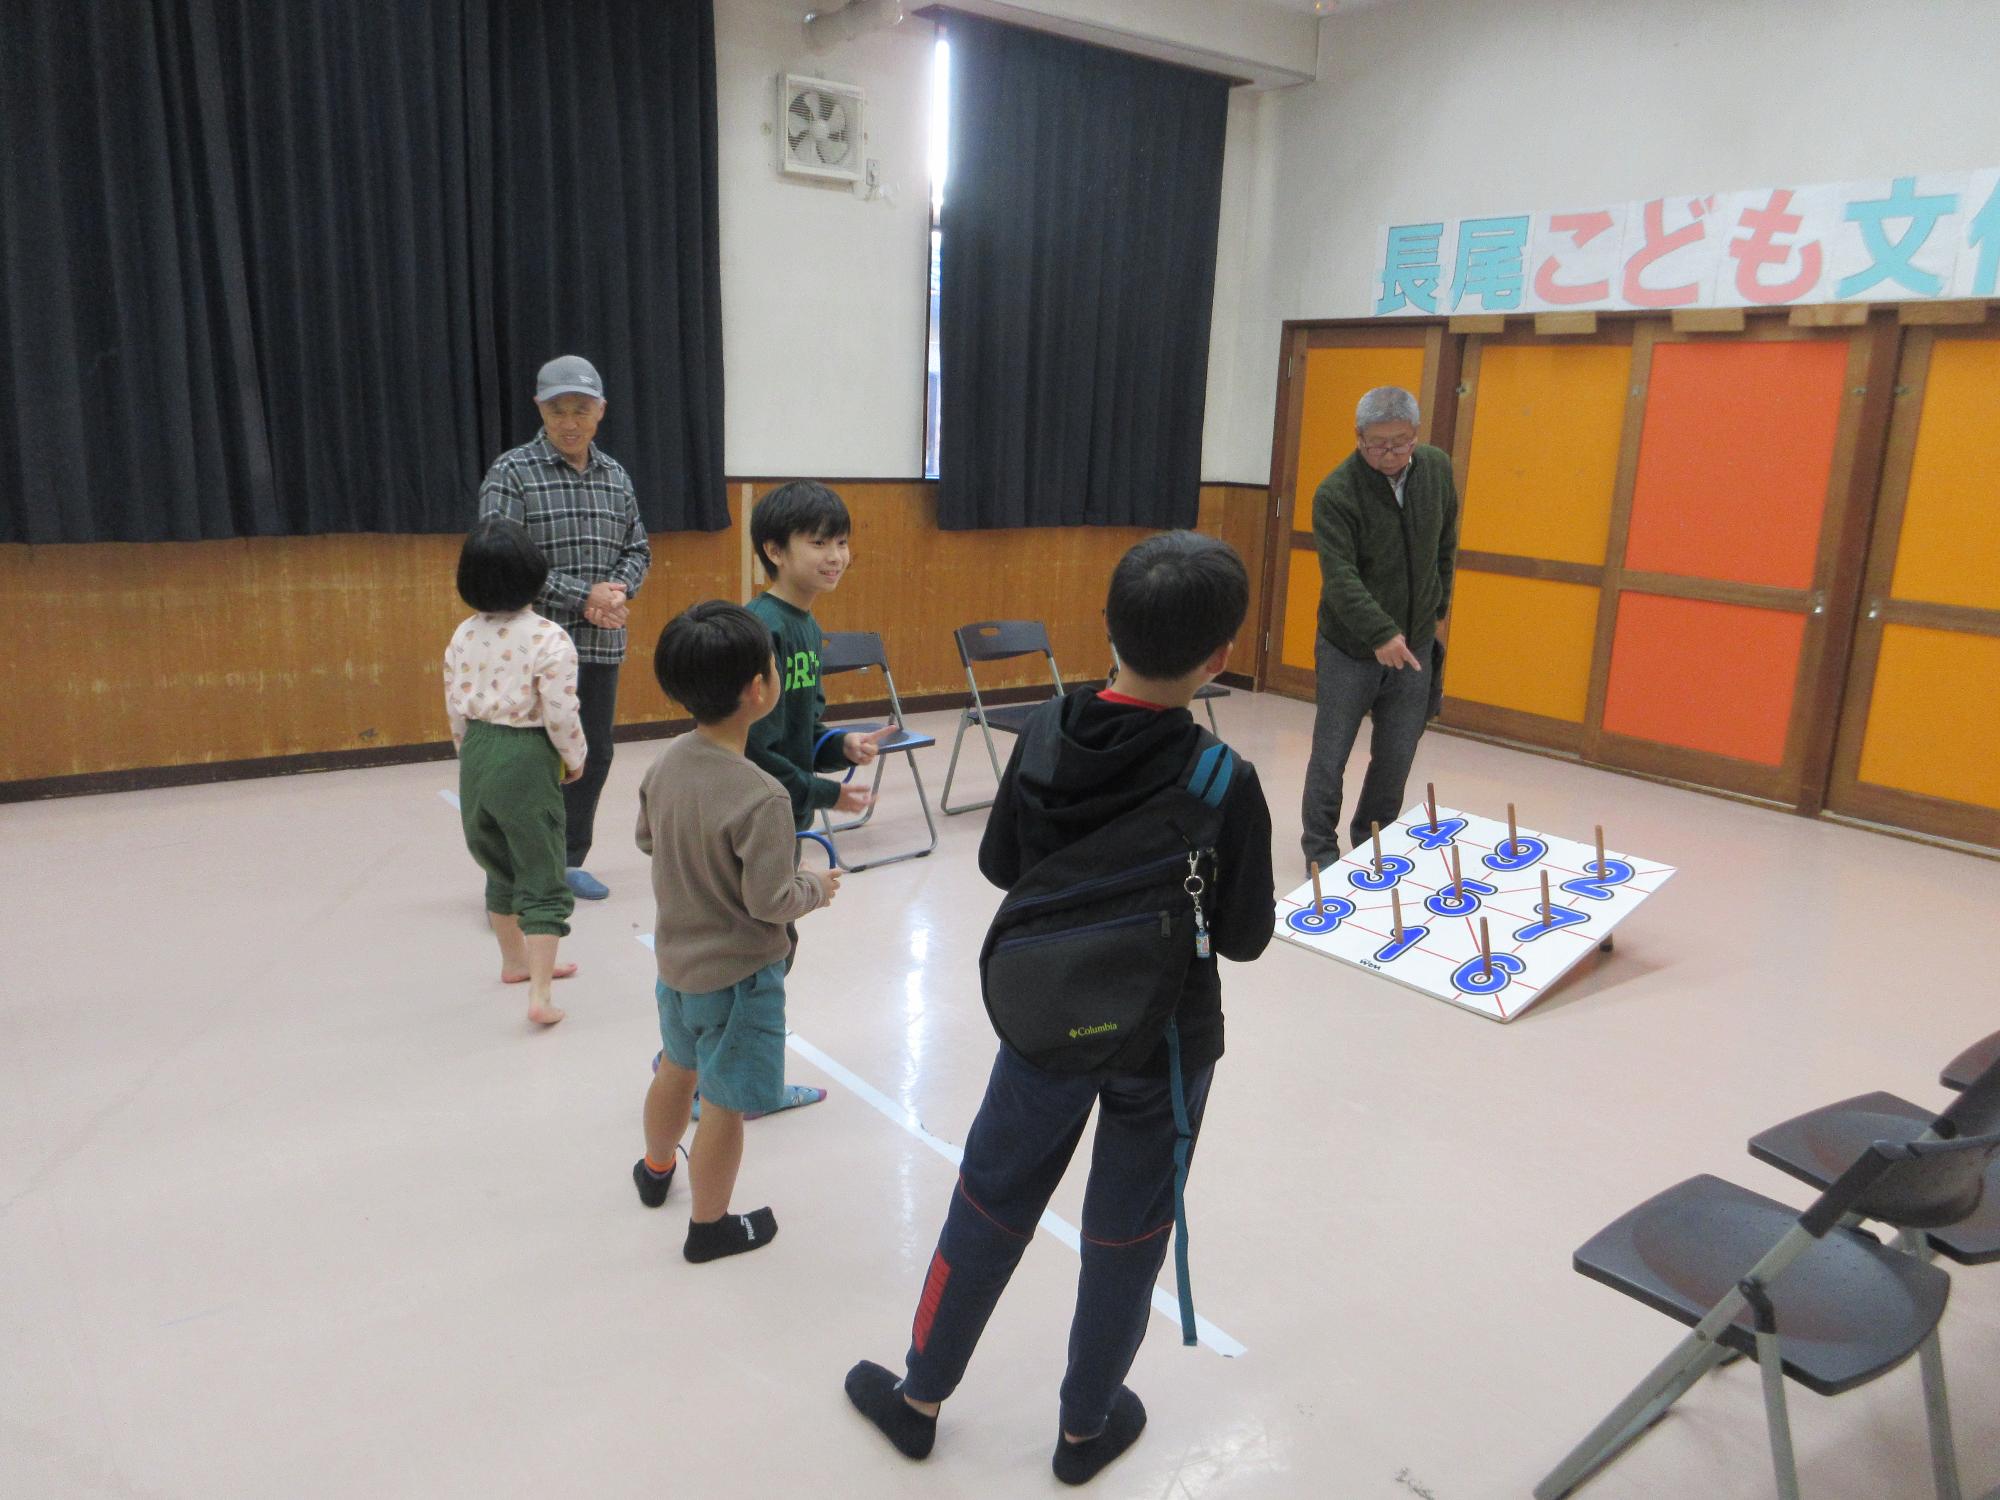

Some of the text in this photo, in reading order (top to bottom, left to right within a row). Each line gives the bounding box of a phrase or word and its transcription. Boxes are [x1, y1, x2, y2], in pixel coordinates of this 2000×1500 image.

[1406, 817, 1468, 850] 4
[1347, 854, 1415, 891] 3
[1482, 836, 1548, 872] 9
[1424, 878, 1498, 917] 5
[1560, 858, 1635, 900] 2
[1286, 895, 1356, 935] 8
[1513, 903, 1591, 942] 7
[1373, 925, 1430, 963] 1
[1450, 951, 1526, 995] 6
[1077, 1021, 1118, 1037] Columbia
